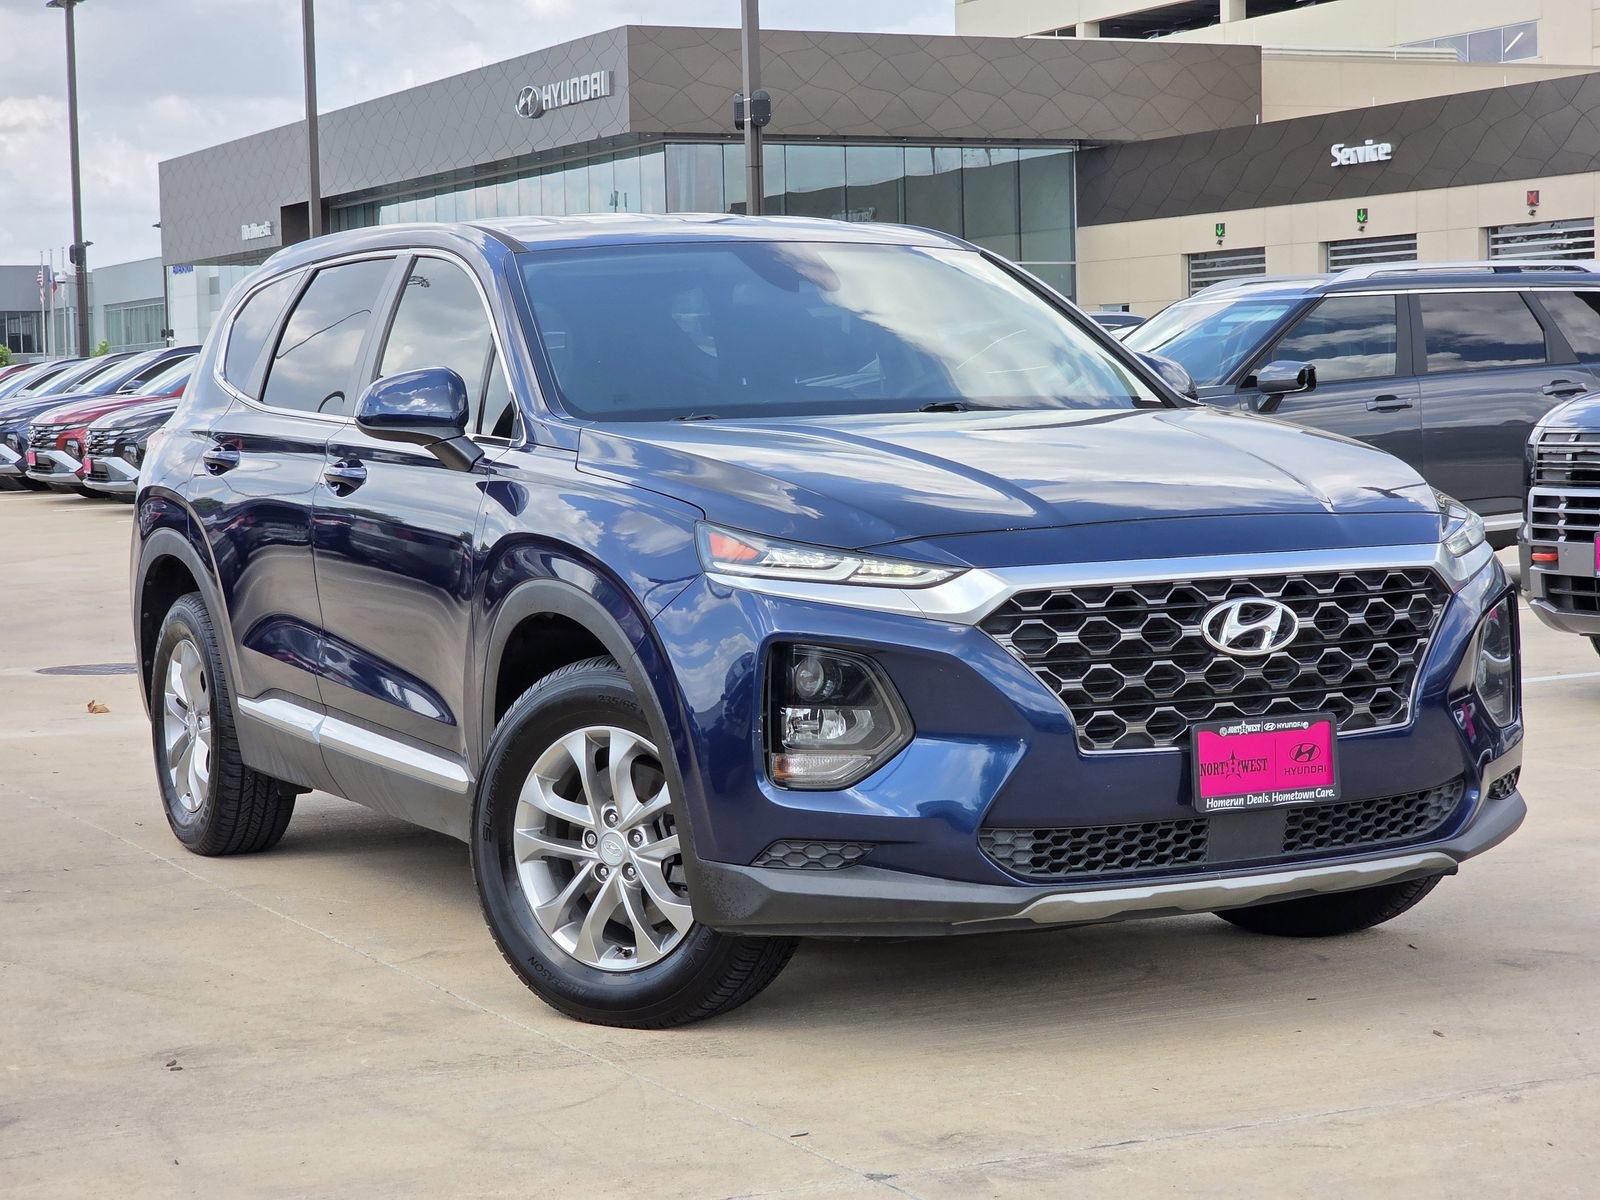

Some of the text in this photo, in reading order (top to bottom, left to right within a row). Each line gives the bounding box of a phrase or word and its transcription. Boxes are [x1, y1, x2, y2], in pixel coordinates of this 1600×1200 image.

[542, 70, 610, 111] HYUNDAI
[1284, 764, 1327, 777] HYUNDAI
[1206, 787, 1335, 809] Homerun Deals. Hometown Care.
